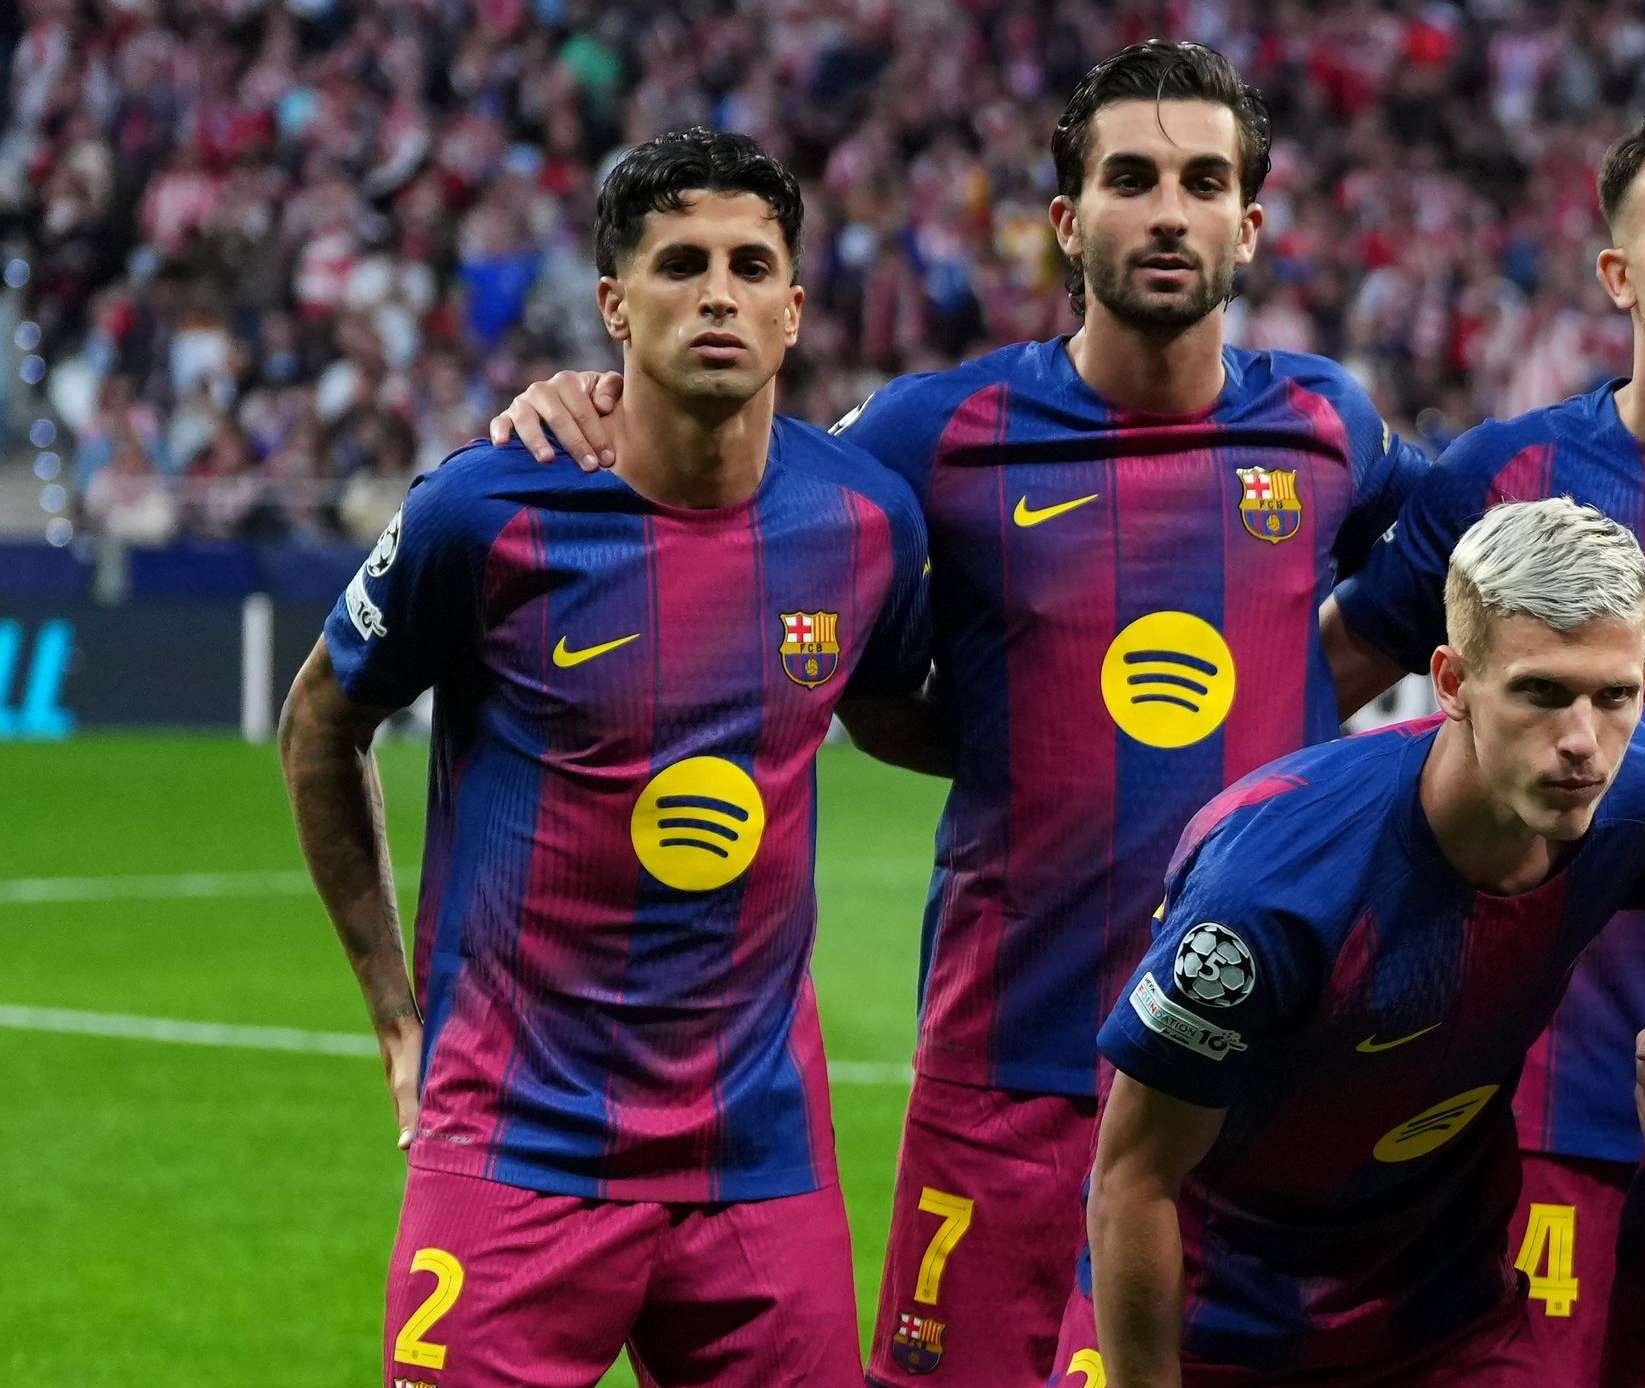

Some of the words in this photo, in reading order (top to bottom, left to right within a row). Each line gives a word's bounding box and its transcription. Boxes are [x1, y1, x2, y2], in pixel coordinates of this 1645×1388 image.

[799, 643, 823, 653] FCB
[1198, 951, 1228, 982] 5
[916, 1187, 975, 1305] 7
[1514, 1203, 1579, 1317] 4
[393, 1247, 465, 1370] 2
